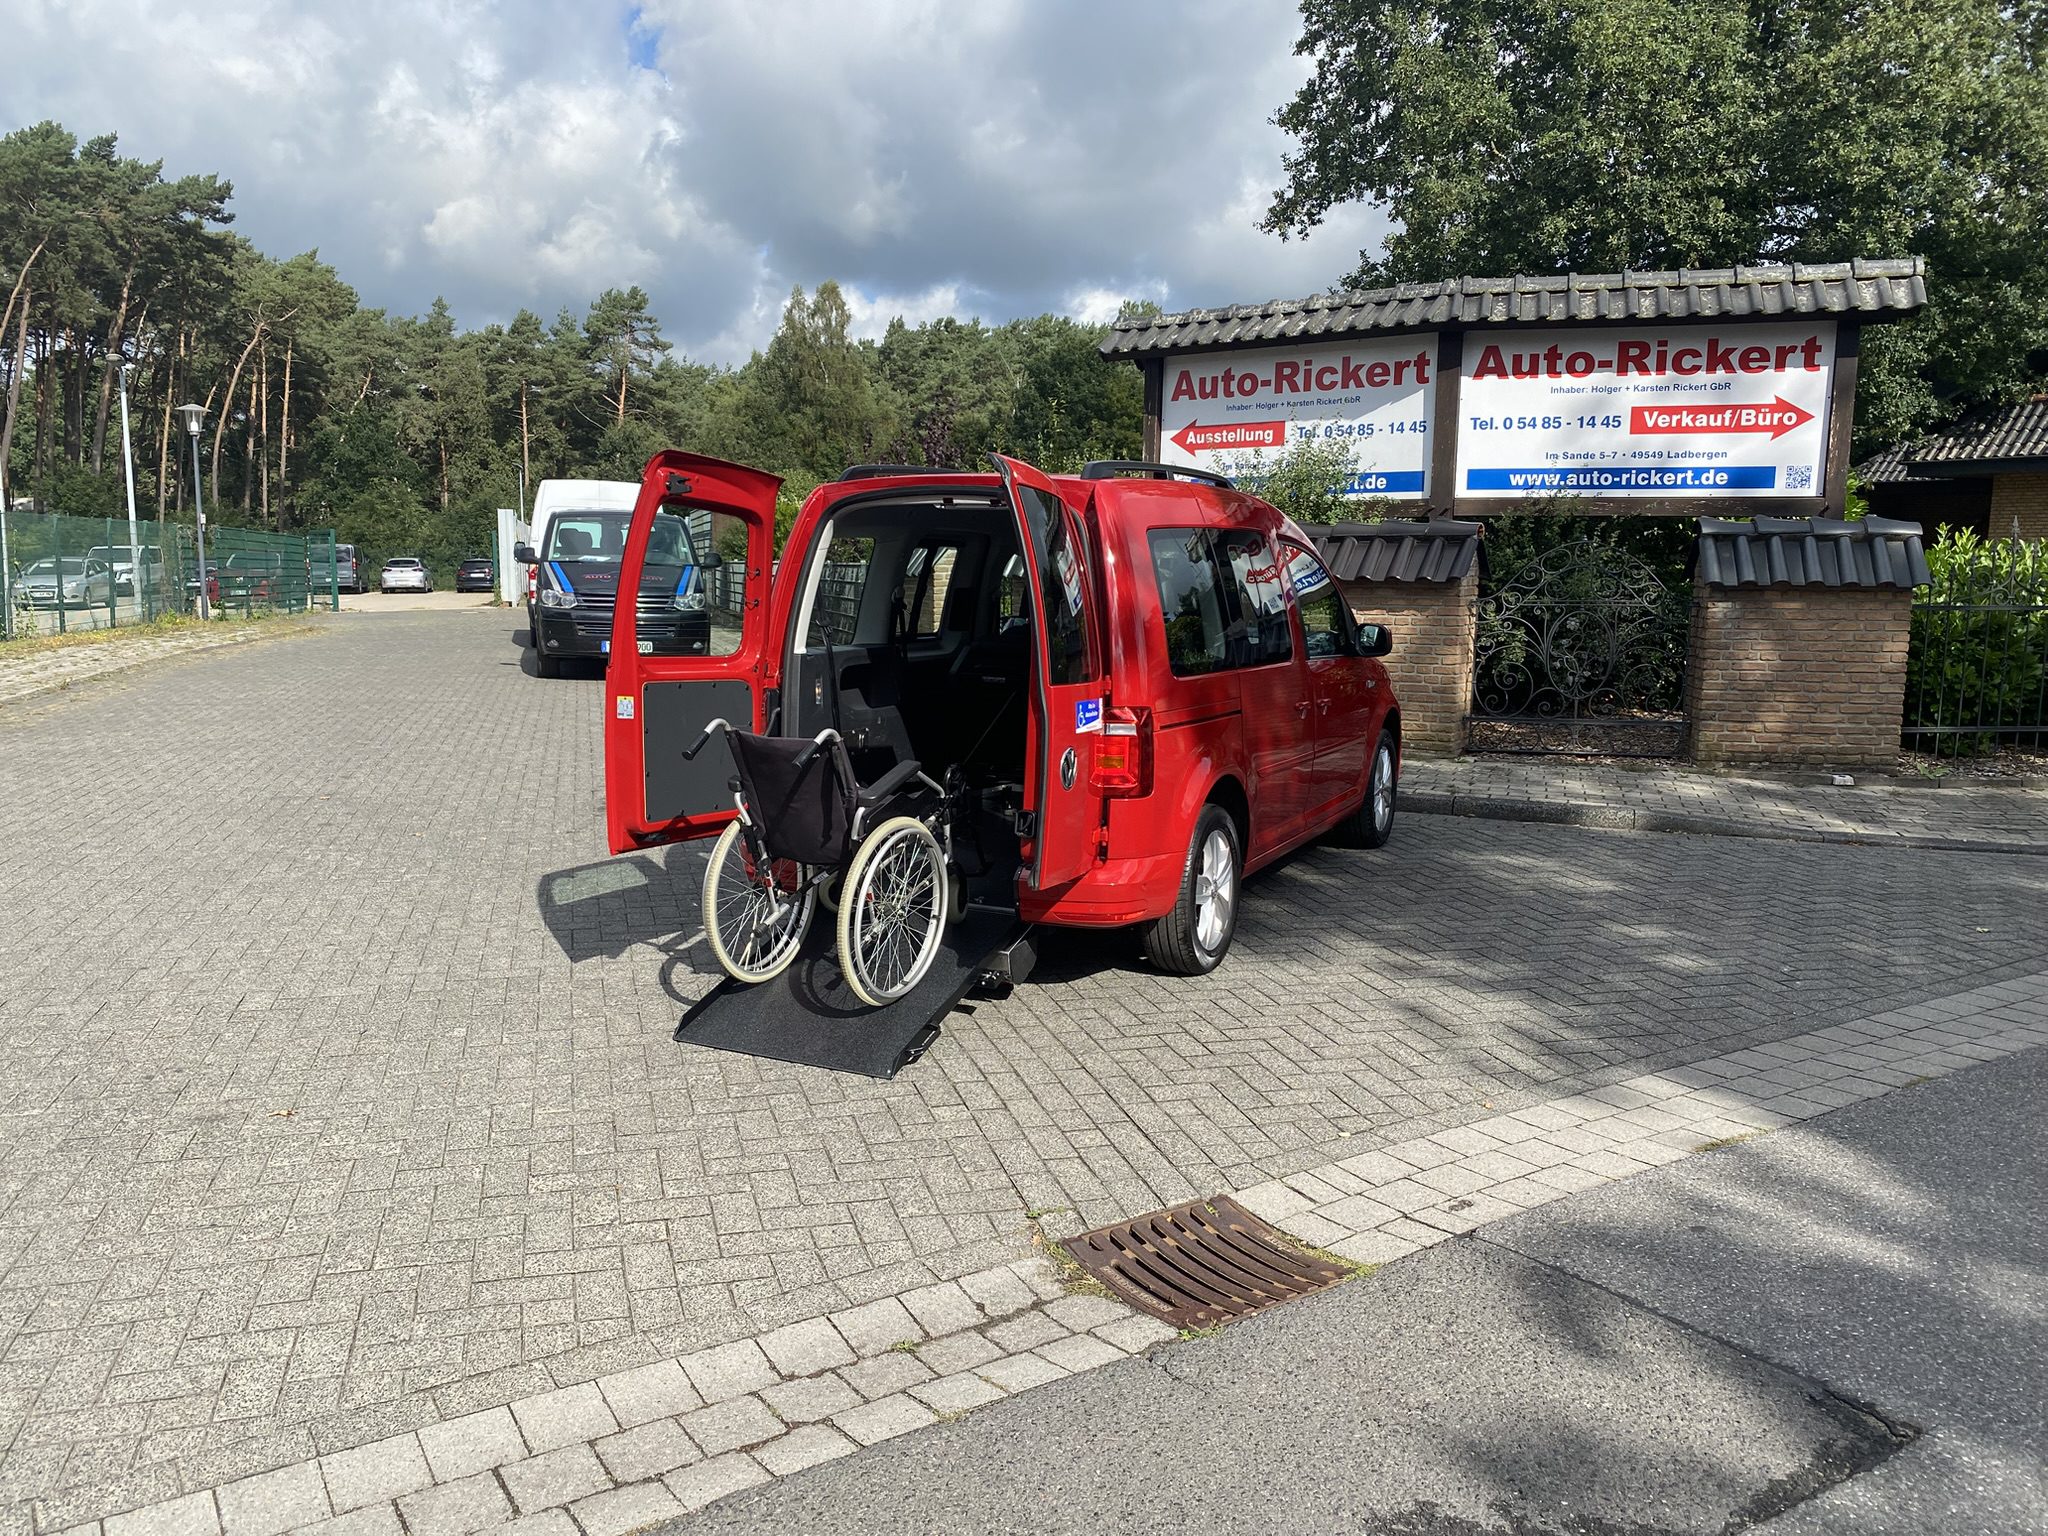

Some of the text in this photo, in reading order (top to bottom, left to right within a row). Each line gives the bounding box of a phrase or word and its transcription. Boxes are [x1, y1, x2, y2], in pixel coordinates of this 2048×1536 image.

[1472, 335, 1822, 381] Auto-Rickert
[1171, 351, 1431, 402] Auto-Rickert
[1550, 386, 1588, 394] Inhaber:
[1591, 385, 1622, 395] Holger
[1633, 384, 1670, 393] Karsten
[1673, 383, 1707, 392] Rickert
[1710, 382, 1732, 391] GbR
[1256, 402, 1278, 410] Holger
[1287, 400, 1314, 408] Karsten
[1316, 397, 1342, 406] Rickert
[1470, 417, 1499, 430] Tel.
[1503, 417, 1513, 430] 0
[1517, 416, 1537, 429] 54
[1541, 416, 1562, 429] 85
[1577, 415, 1597, 428] 14
[1601, 415, 1621, 428] 45
[1643, 408, 1798, 428] Verkauf/Büro
[1186, 428, 1274, 445] Ausstellung
[1297, 427, 1320, 438] Tel.
[1357, 423, 1374, 436] 85
[1389, 422, 1404, 434] 14
[1409, 420, 1427, 433] 45
[1546, 452, 1559, 460] Im
[1562, 451, 1596, 460] Sande
[1631, 450, 1663, 459] 49549
[1667, 450, 1728, 461] Ladbergen
[1509, 467, 1728, 486] www.auto-rickert.de
